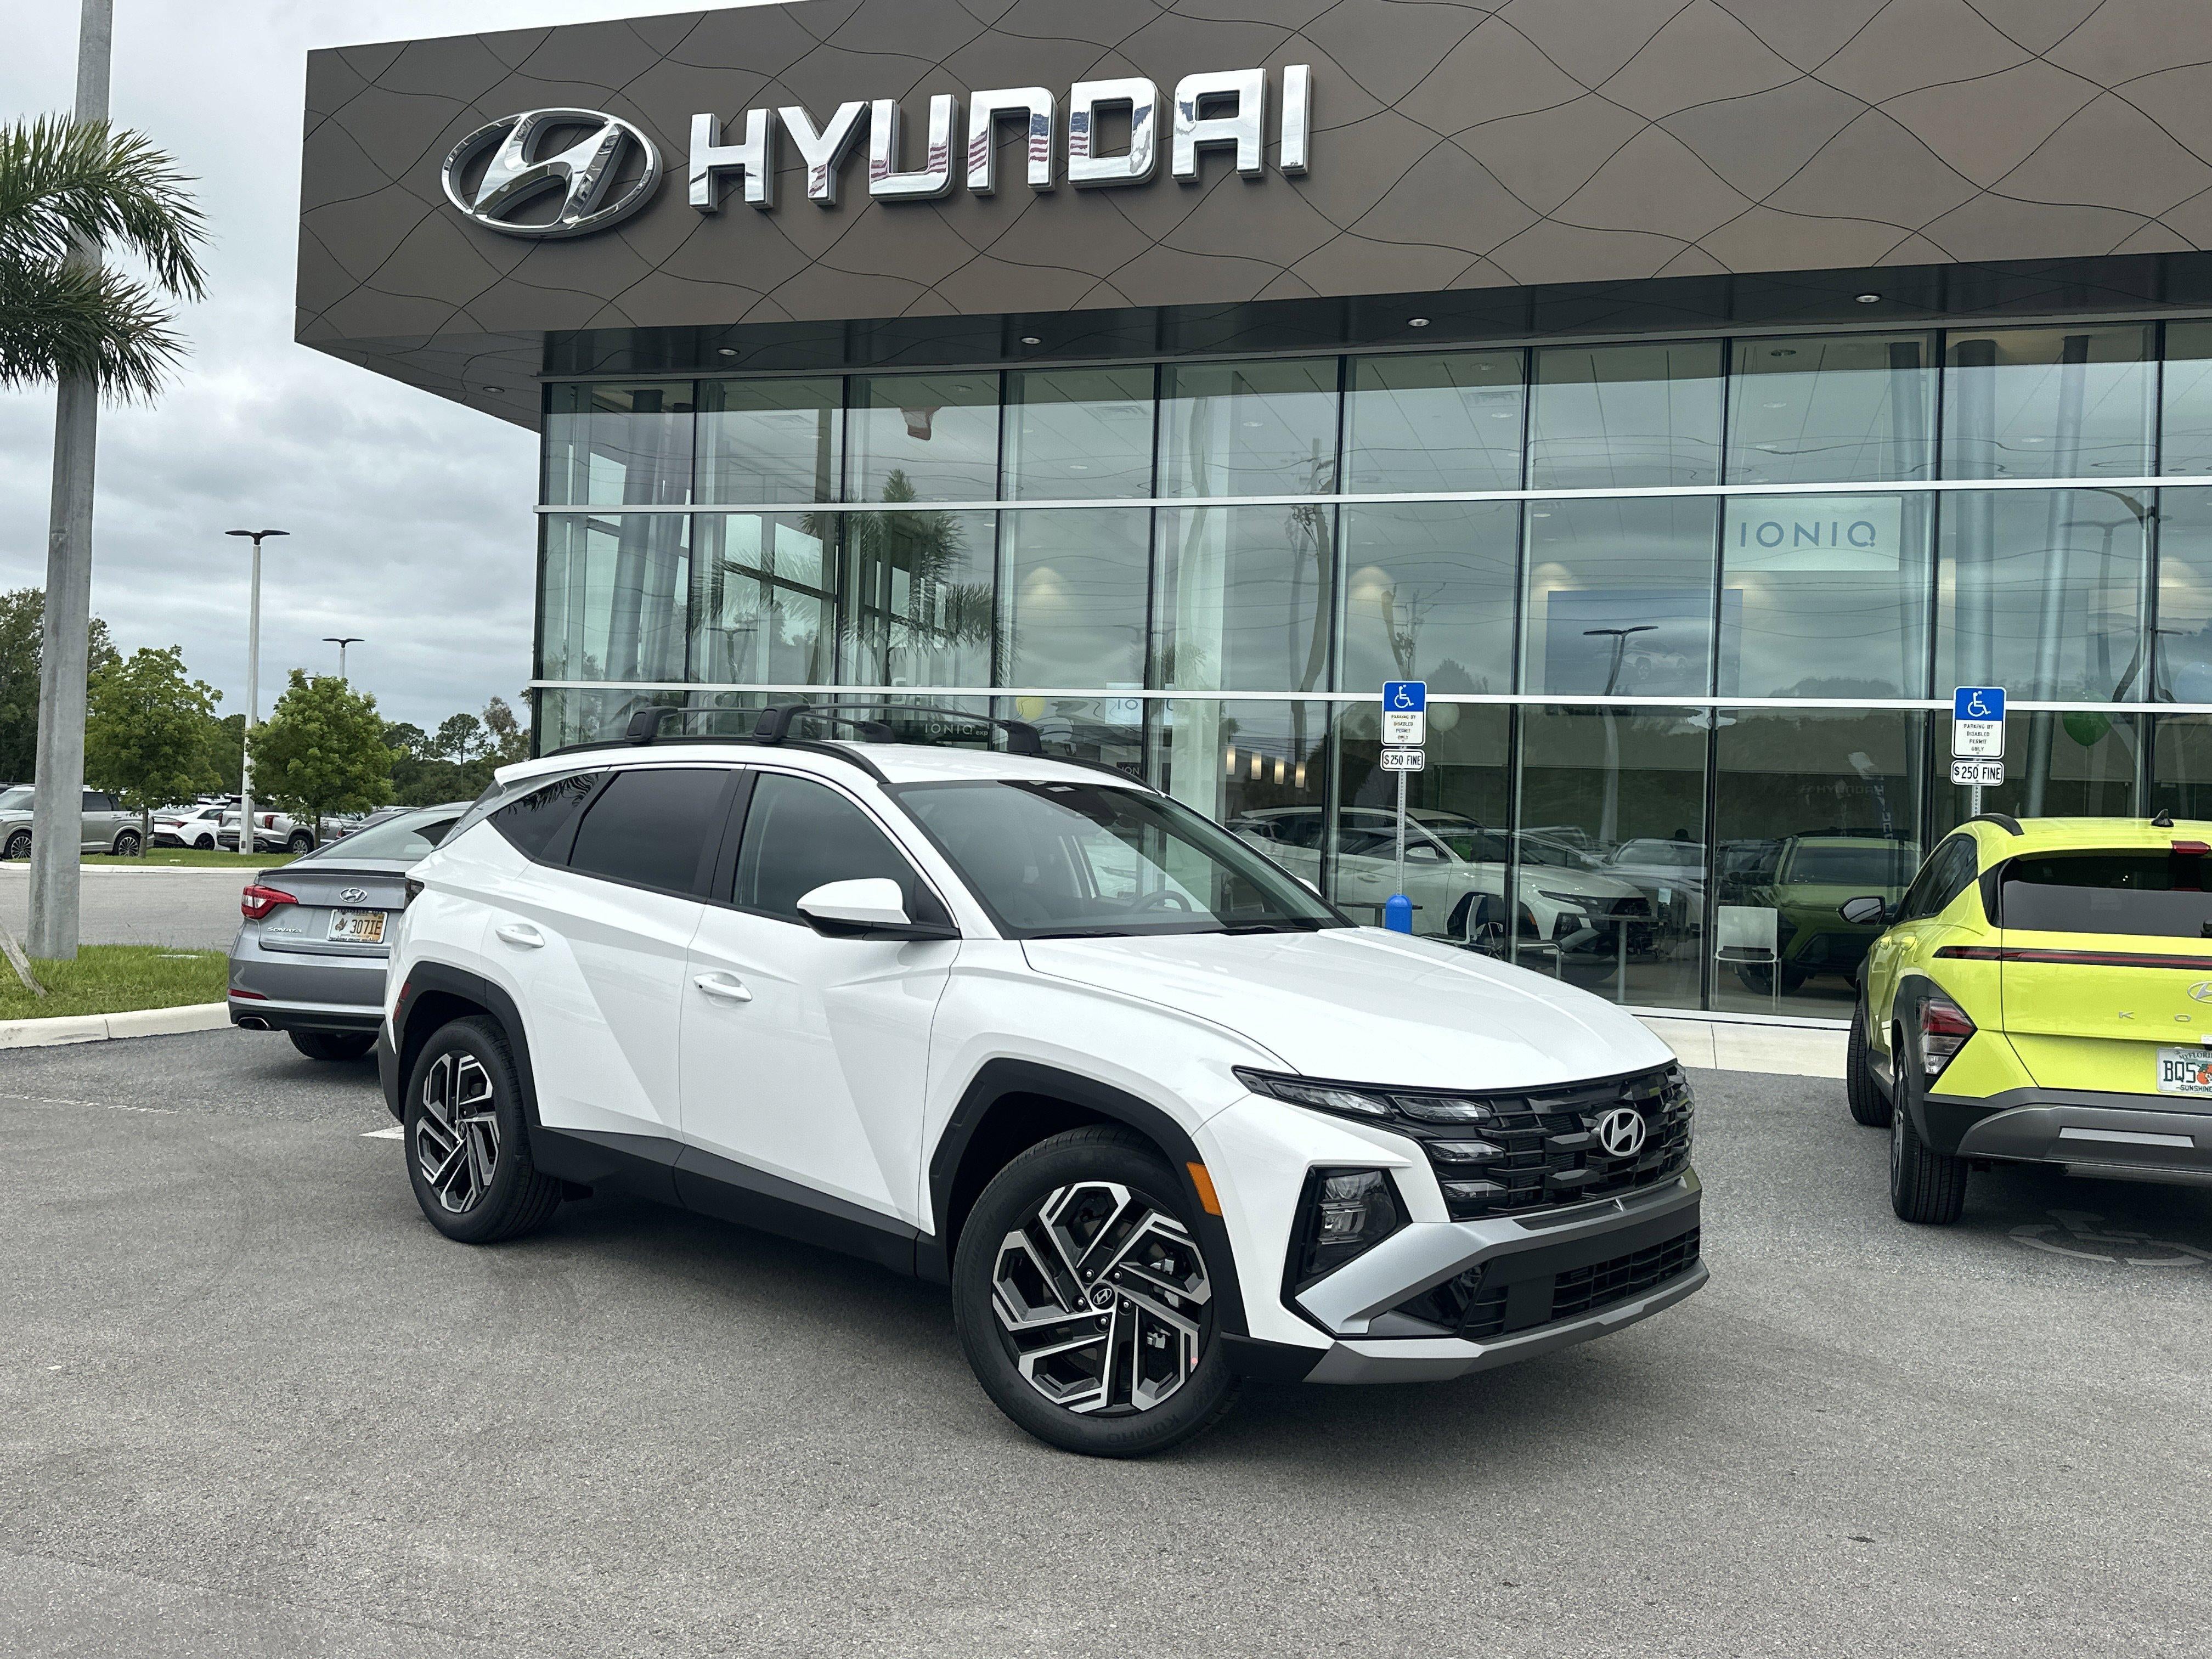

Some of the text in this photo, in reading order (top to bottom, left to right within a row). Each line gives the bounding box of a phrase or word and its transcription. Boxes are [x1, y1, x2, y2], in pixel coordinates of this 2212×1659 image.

[688, 63, 1313, 213] HYUNDAI
[1740, 521, 1876, 548] IONIQ
[925, 723, 973, 735] IONIQ
[1384, 755, 1421, 765] $250 FINE
[1954, 766, 2001, 780] $250 FINE
[2179, 1052, 2212, 1060] MYFLORI
